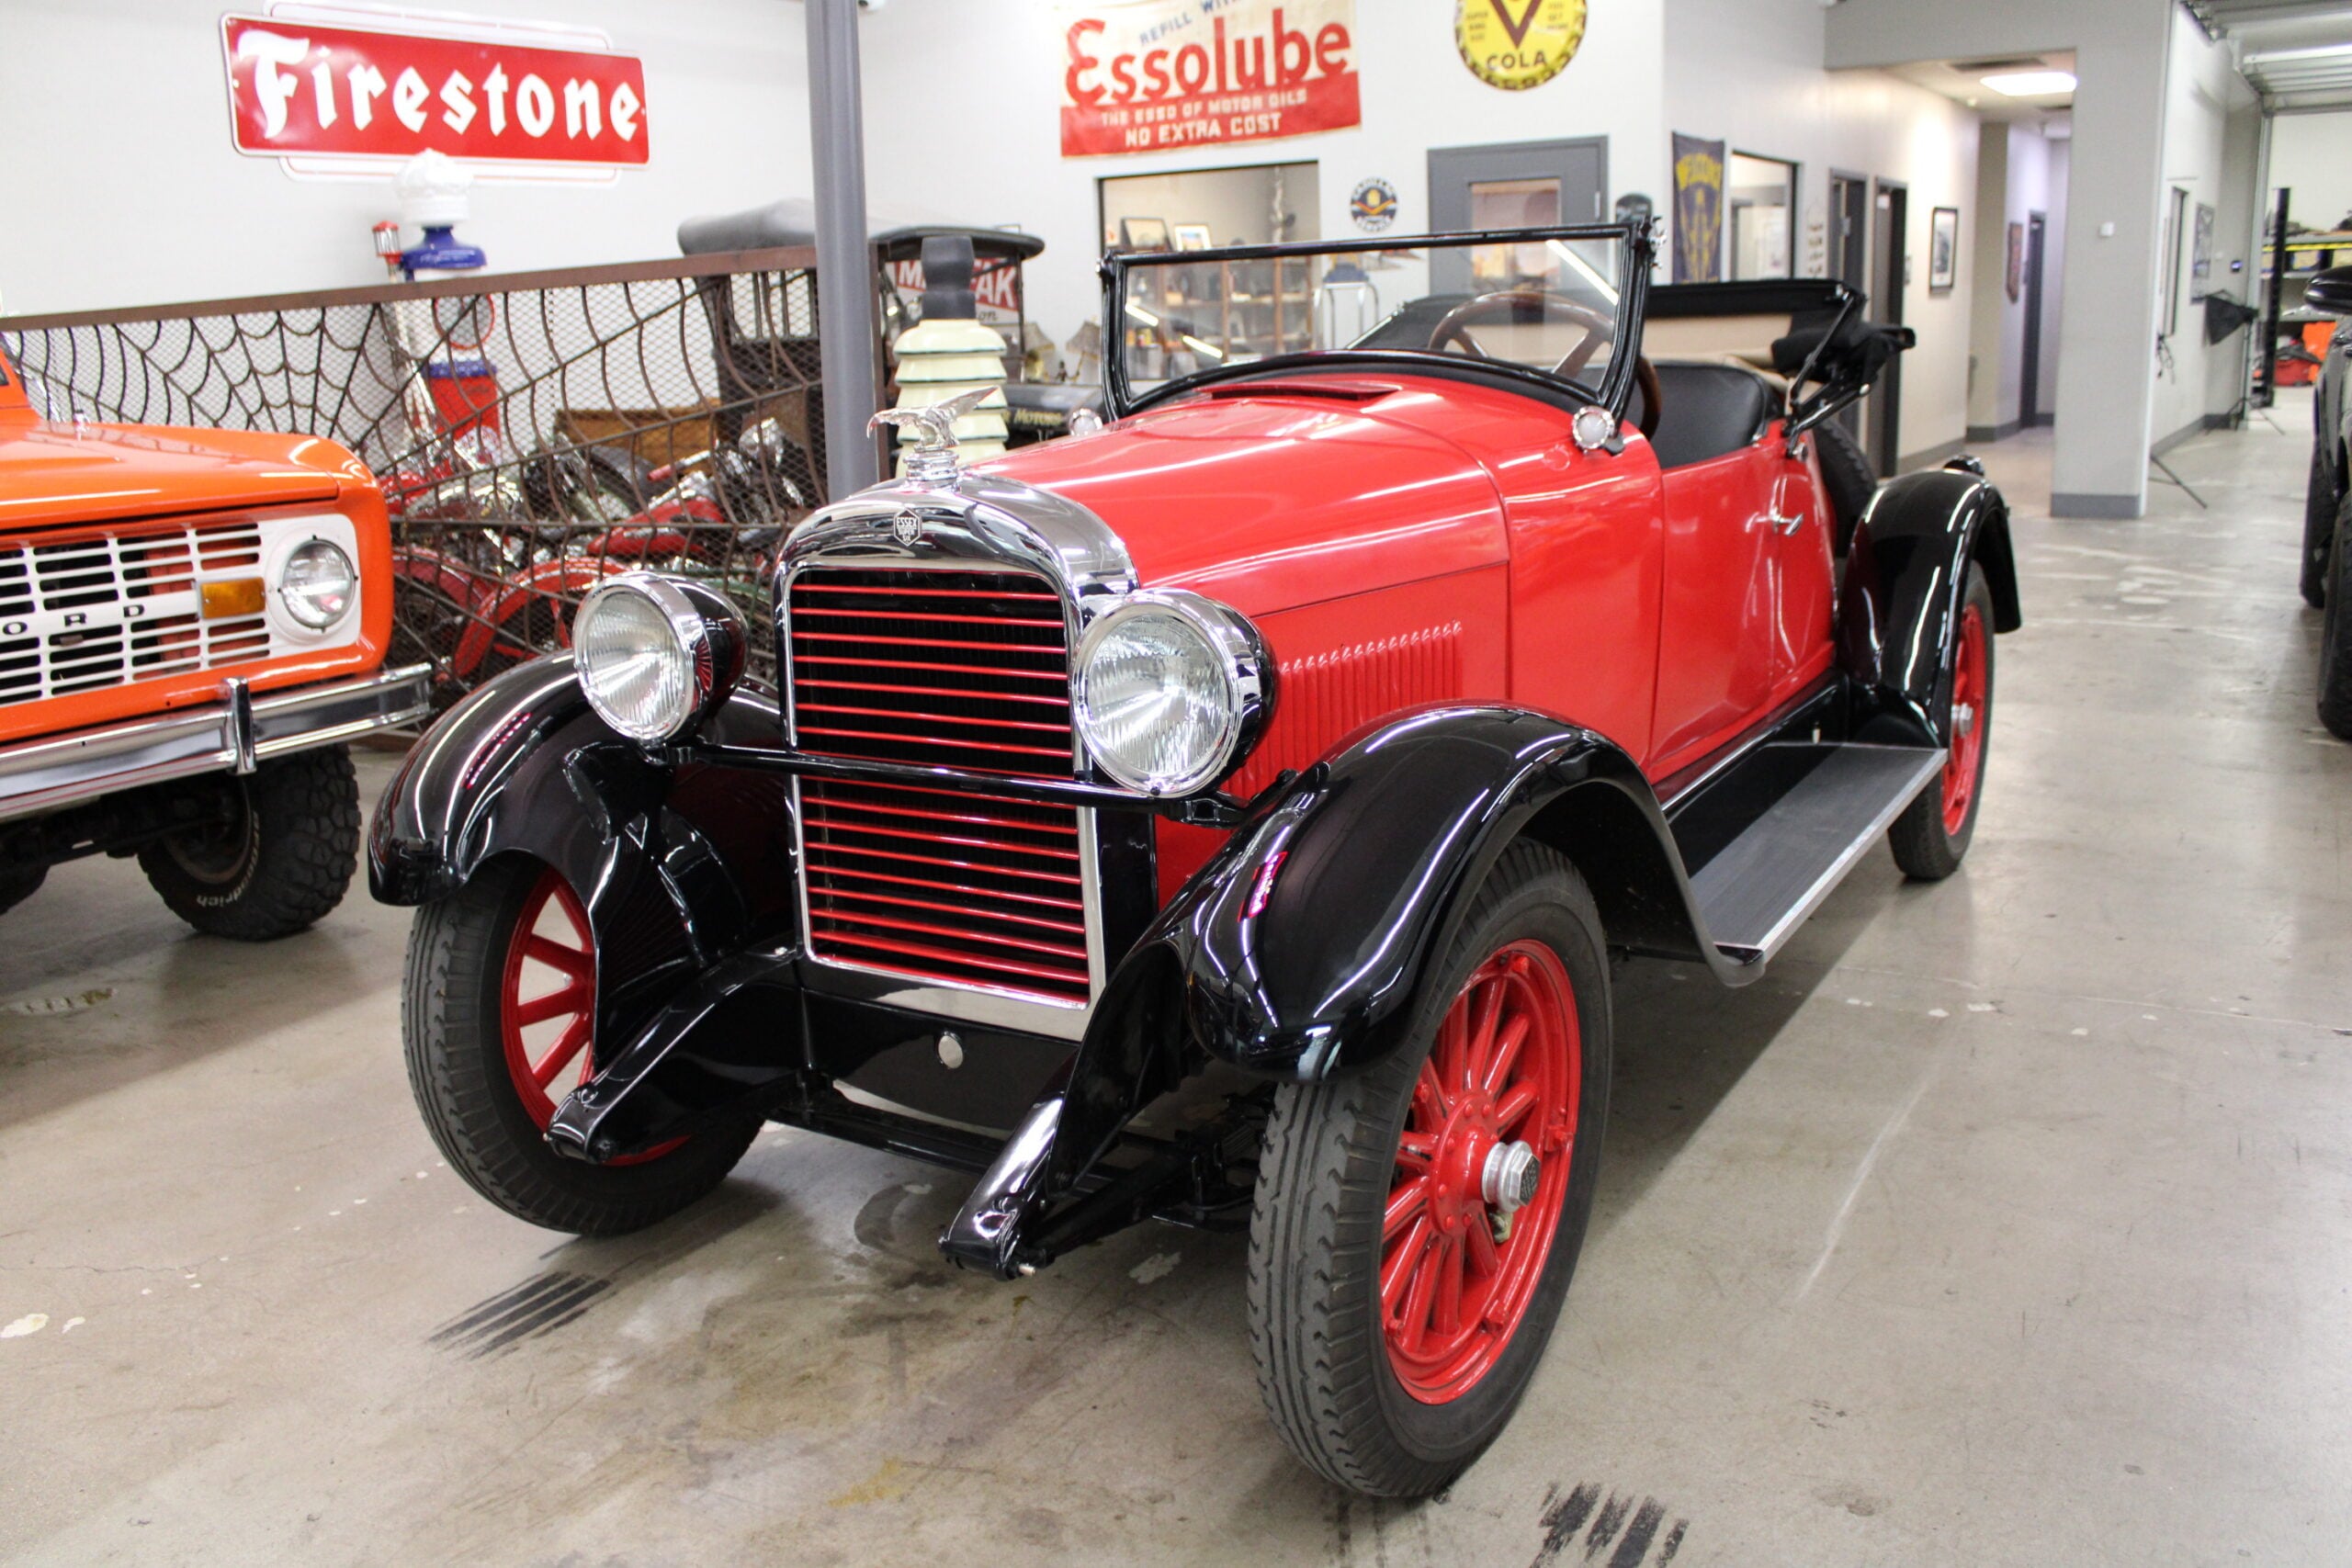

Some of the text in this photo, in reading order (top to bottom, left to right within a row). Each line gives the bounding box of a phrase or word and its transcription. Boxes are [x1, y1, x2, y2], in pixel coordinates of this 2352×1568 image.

[1139, 0, 1240, 44] REFILL WI
[1066, 8, 1351, 105] Essolube
[1487, 51, 1546, 72] COLA
[238, 29, 640, 142] Firestone
[1102, 108, 1128, 127] THE
[1182, 101, 1204, 117] OF
[1208, 95, 1262, 115] MOTOR
[1269, 87, 1307, 108] OILS
[1125, 112, 1283, 148] NO EXTRA COST
[897, 517, 917, 528] ESSEX
